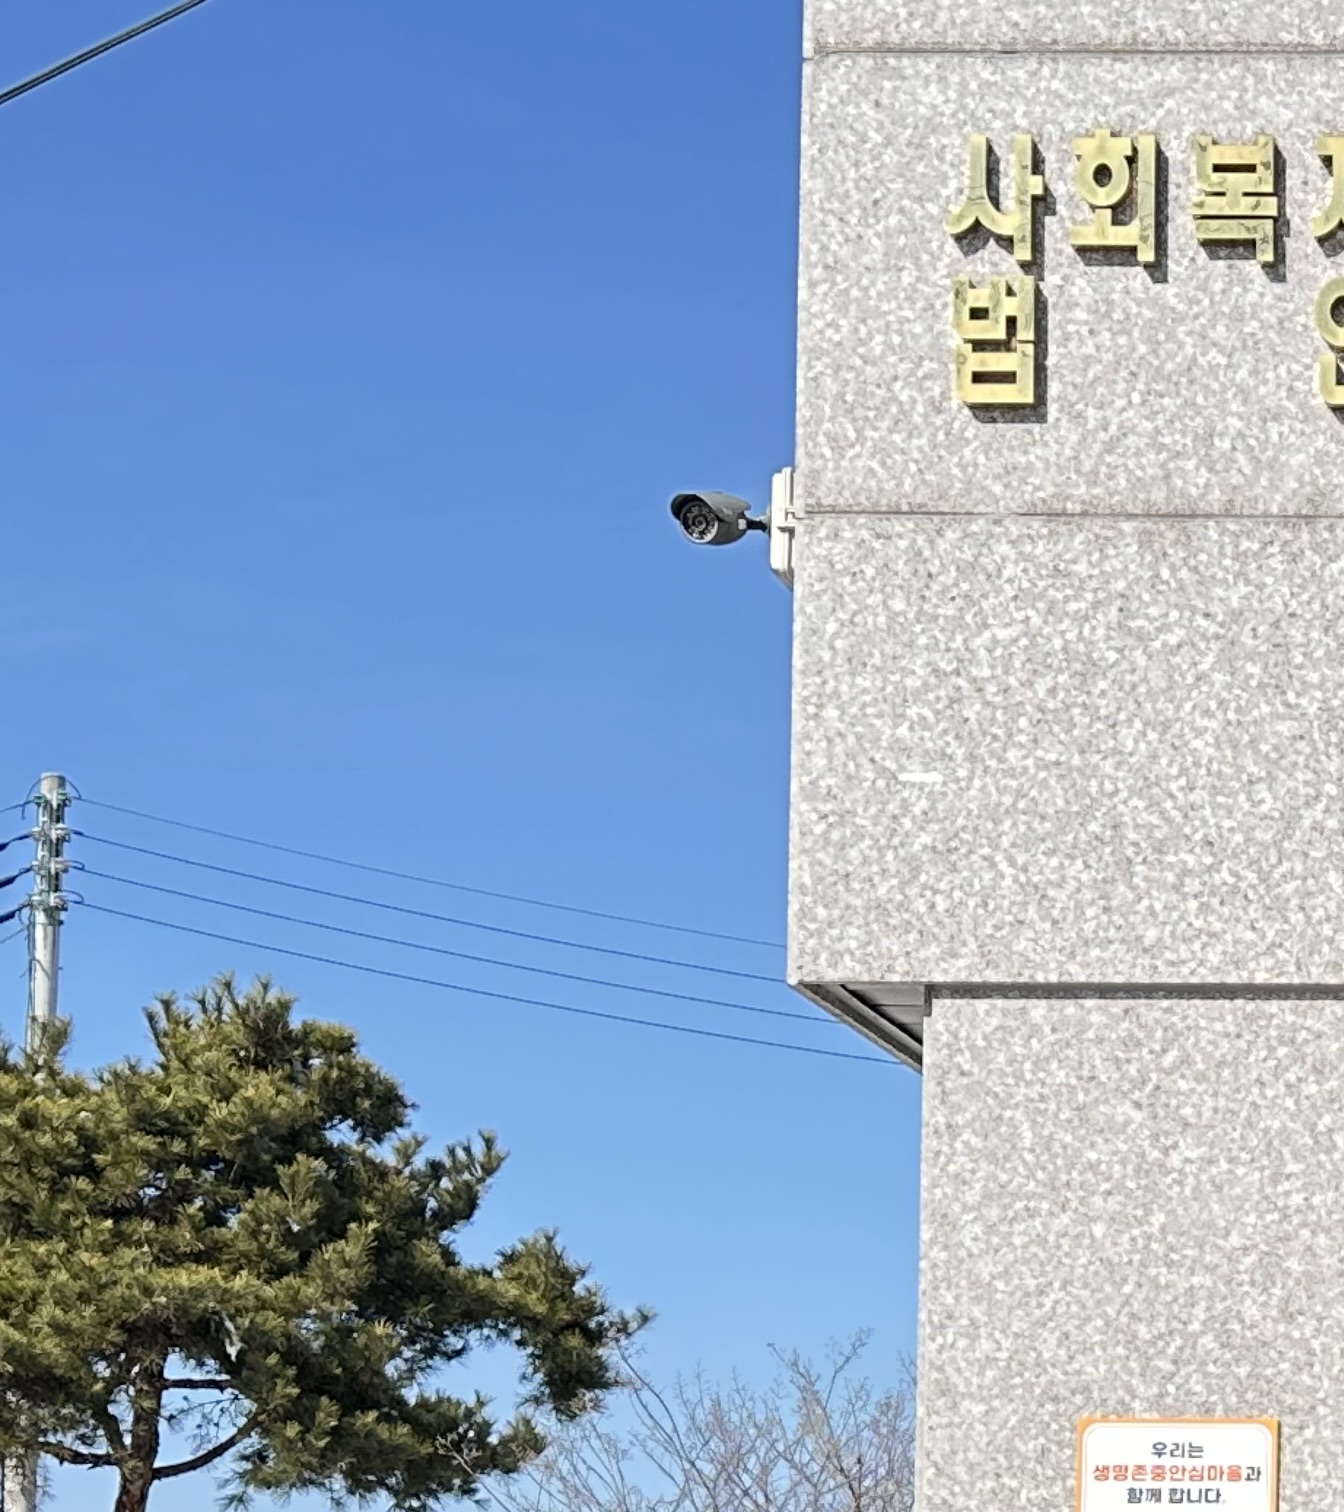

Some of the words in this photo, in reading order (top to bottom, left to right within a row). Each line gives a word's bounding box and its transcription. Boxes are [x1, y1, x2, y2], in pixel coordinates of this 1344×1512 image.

[1151, 1441, 1205, 1459] 우리는
[1092, 1464, 1262, 1483] 생명존중안심마을과
[1127, 1487, 1162, 1504] 함께
